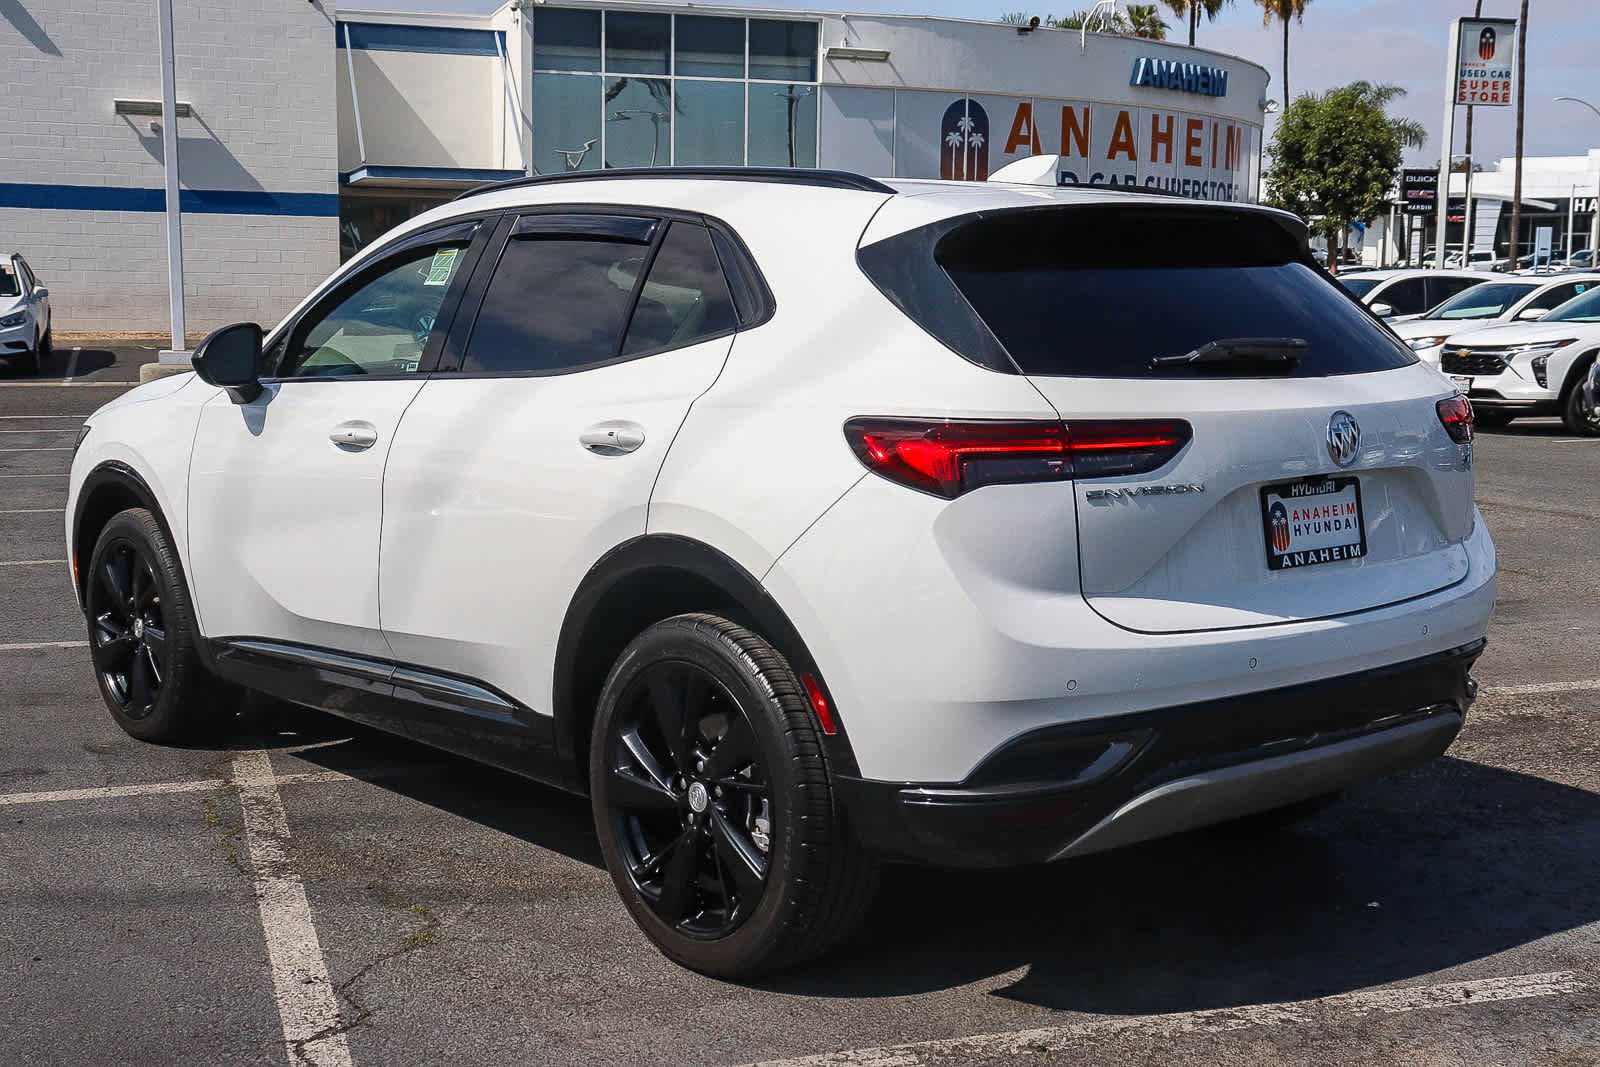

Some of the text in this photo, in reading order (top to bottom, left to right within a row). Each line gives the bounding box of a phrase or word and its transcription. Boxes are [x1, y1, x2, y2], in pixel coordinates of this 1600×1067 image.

[1129, 57, 1228, 97] ANAHEIM
[1460, 69, 1512, 79] USED CAR
[1460, 80, 1511, 91] SUPER
[1459, 91, 1511, 103] STORE
[1003, 102, 1241, 172] ANAHEIM
[1086, 482, 1205, 500] ENVISION
[1293, 502, 1356, 522] ANAHEIM
[1293, 517, 1358, 536] HYUNDAI
[1282, 544, 1361, 568] ANAHEIM
